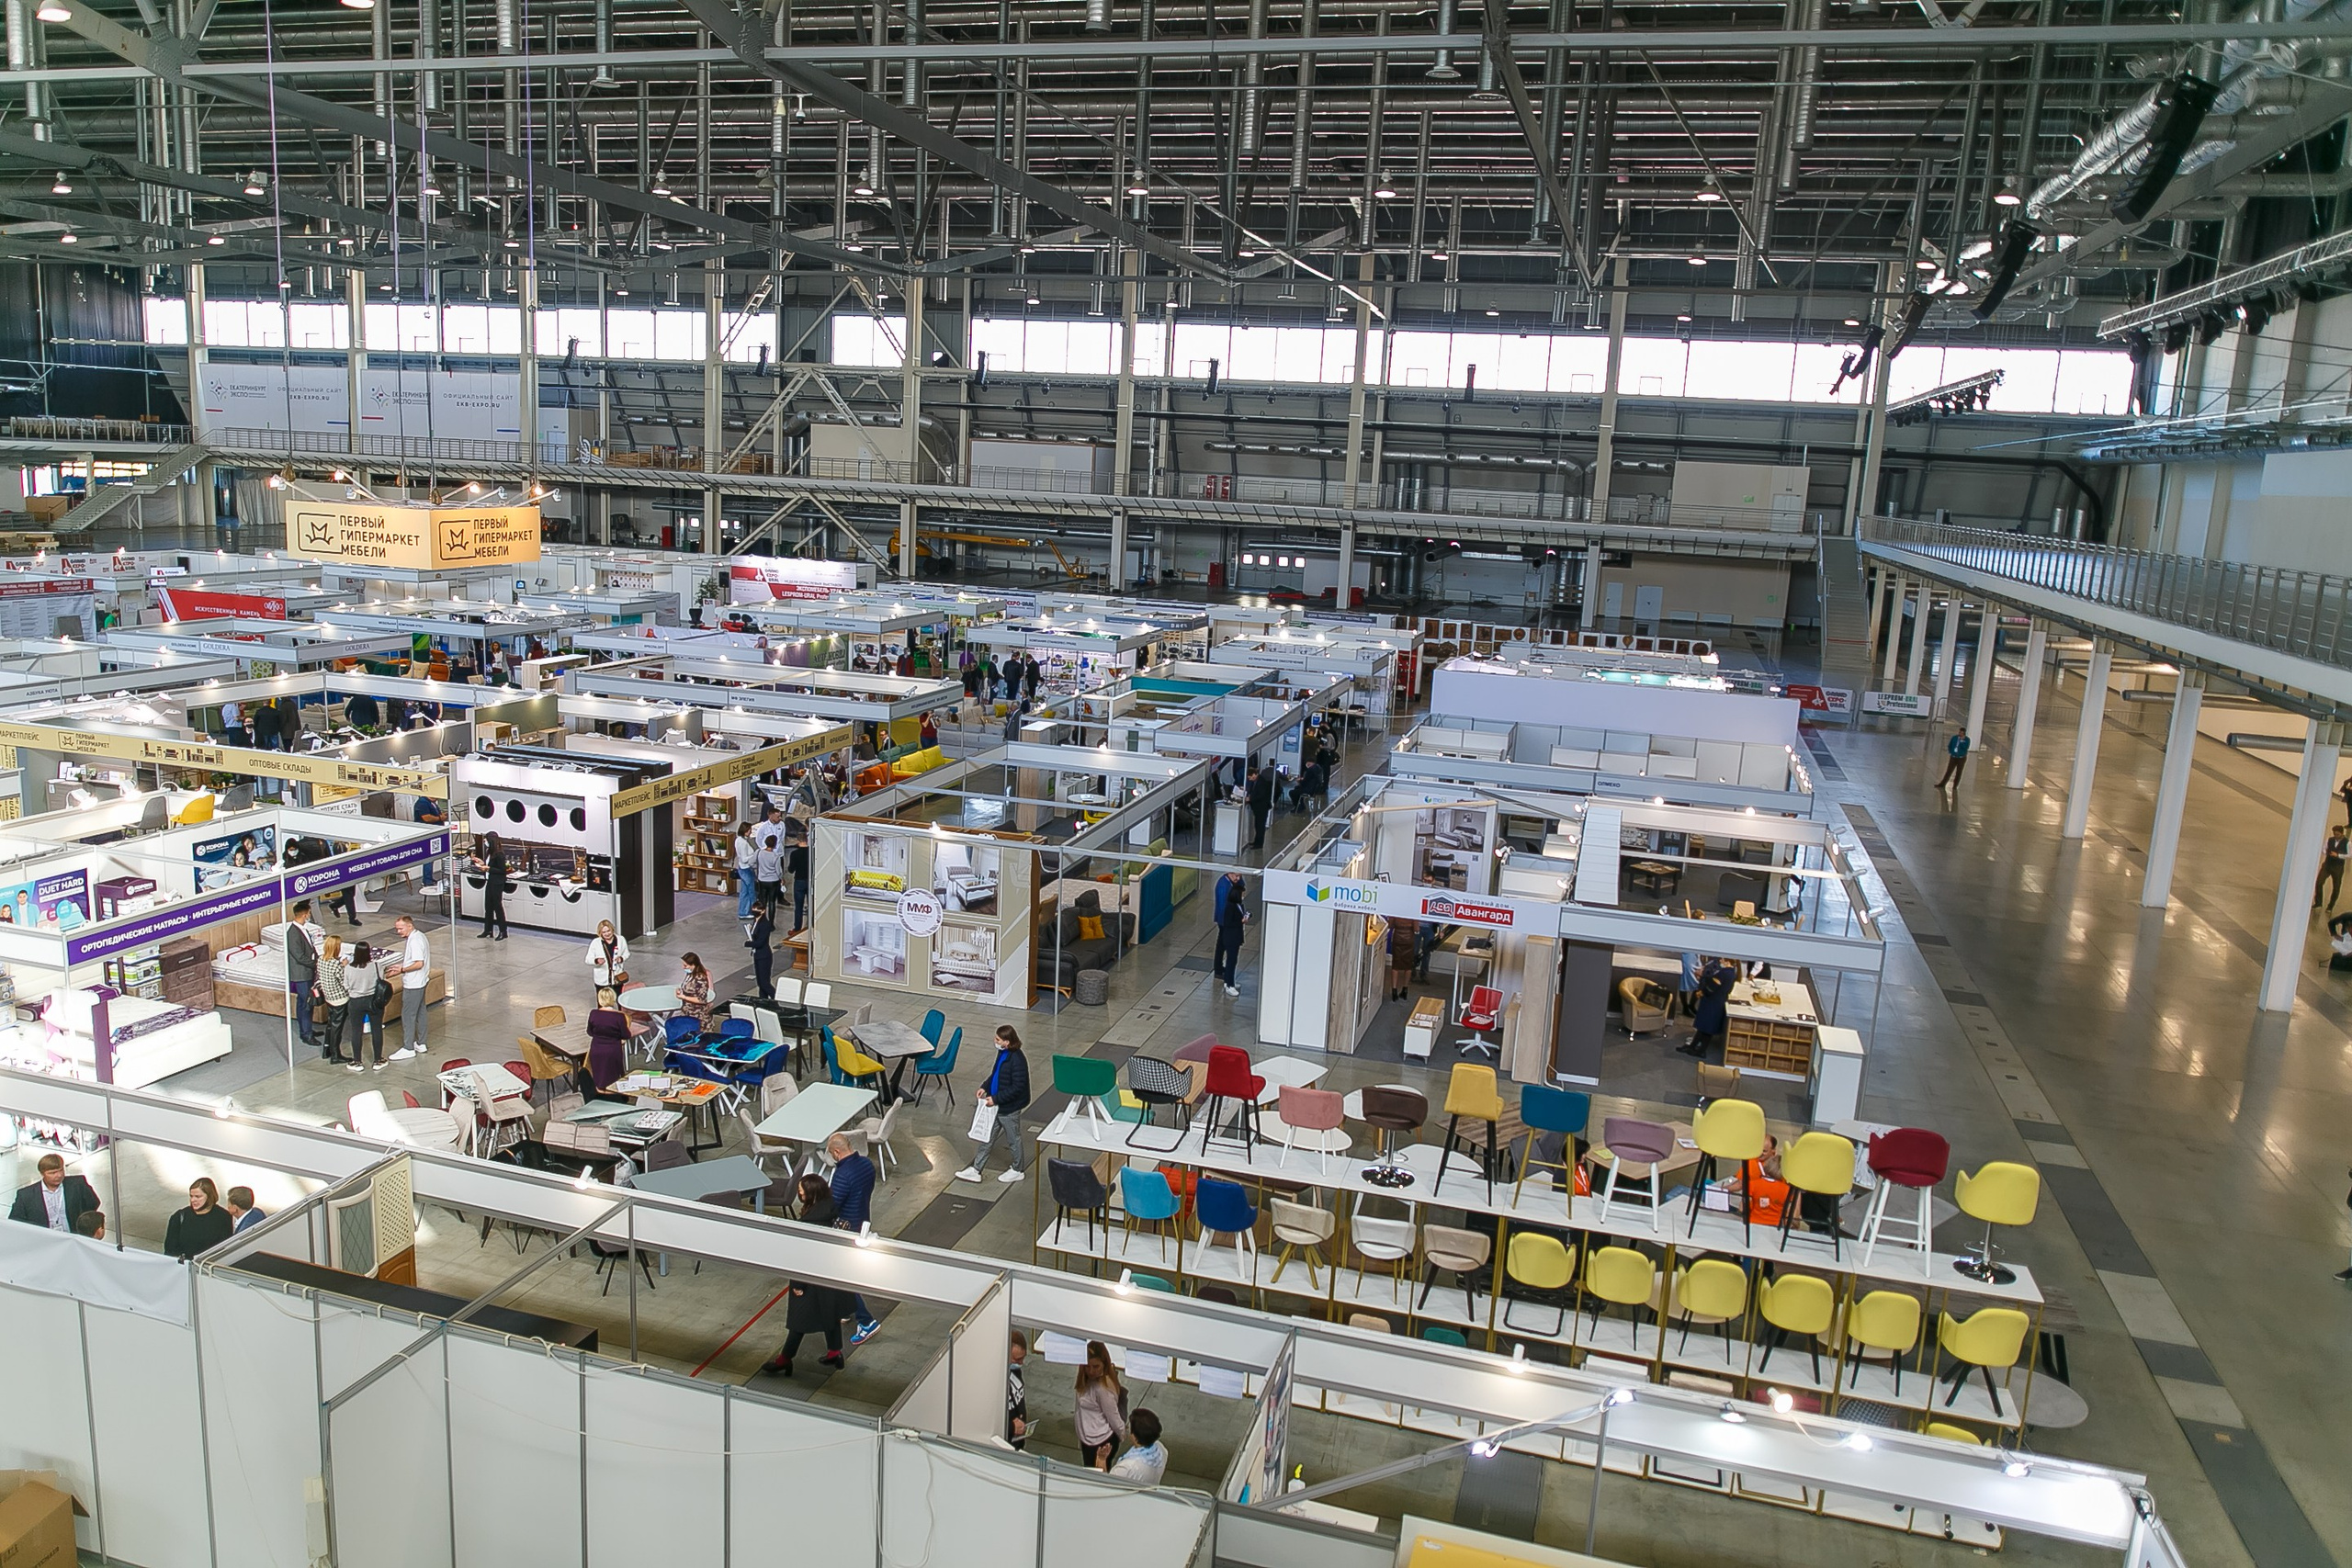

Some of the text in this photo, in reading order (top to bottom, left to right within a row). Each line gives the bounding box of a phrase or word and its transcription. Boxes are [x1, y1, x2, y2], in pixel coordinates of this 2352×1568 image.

[230, 384, 266, 392] ЕКАТЕРИНБУРГ
[339, 514, 385, 529] ПЕРВЫЙ
[473, 514, 509, 530] ПЕРВЫЙ
[340, 529, 421, 547] ГИПЕРМАРКЕТ
[473, 529, 534, 544] ГИПЕРМАРКЕТ
[340, 545, 387, 558] МЕБЕЛИ
[474, 545, 509, 558] МЕБЕЛИ
[194, 605, 237, 615] ИСКУССТВЕННЫЙ
[239, 609, 261, 617] КАМЕНЬ
[202, 642, 231, 651] GOLDERA
[345, 642, 371, 652] GOLDERA
[1877, 694, 1918, 703] LESPROM-URAL
[1886, 701, 1918, 709] Professional
[75, 732, 96, 740] ПЕРВЫЙ
[829, 733, 850, 746] ФРАНШИЗА
[76, 739, 110, 749] ГИПЕРМАРКЕТ
[248, 758, 312, 774] ОПТОВЫЕ СКЛАДЫ
[741, 755, 756, 765] ПЕРВЫЙ
[741, 759, 764, 773] ГИПЕРМАРКЕТ
[741, 768, 755, 777] МЕБЕЛИ
[613, 791, 651, 810] МАРКЕТПЛЕЙС
[206, 840, 230, 851] КОРОНА
[348, 862, 371, 874] МЕБЕЛЬ
[377, 853, 398, 866] ТОВАРЫ
[399, 850, 411, 860] ДЛЯ
[411, 847, 423, 855] СНА
[308, 868, 340, 885] КОРОНА
[39, 885, 61, 896] DUET
[61, 877, 85, 890] HARD
[1334, 884, 1378, 904] mobi
[907, 902, 933, 914] ММФ
[1357, 904, 1377, 912] мебели
[1463, 898, 1494, 908] торговый
[1456, 904, 1511, 923] Авангард
[81, 890, 271, 953] ОРТОПЕДИЧЕСКИЕ МАТРАСЫ ИНТЕРЬЕРНЫЕ КРОВАТИ
